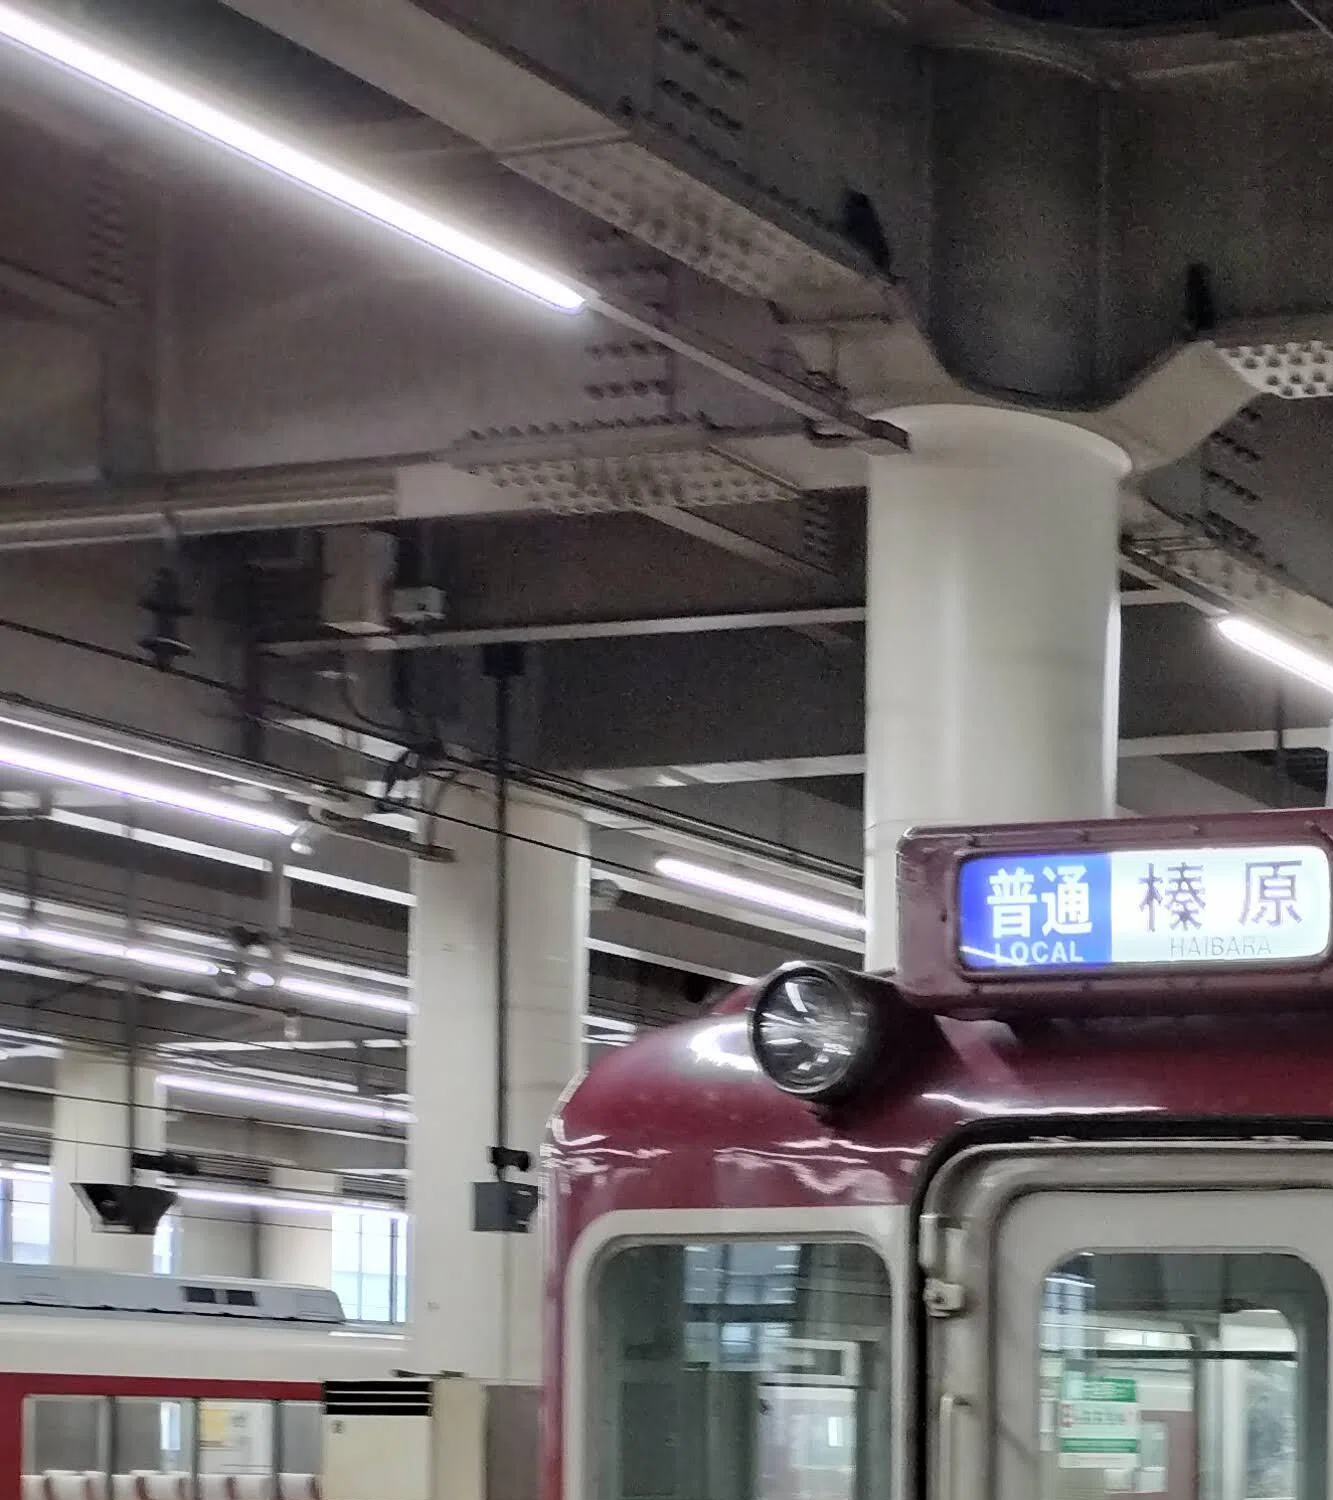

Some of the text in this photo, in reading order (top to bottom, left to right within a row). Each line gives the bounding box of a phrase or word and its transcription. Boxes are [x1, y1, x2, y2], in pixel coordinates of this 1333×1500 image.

[986, 865, 1093, 939] 普通
[1138, 860, 1303, 932] 榛原
[994, 940, 1085, 964] LOCAL
[1169, 935, 1272, 958] HAIBARA
